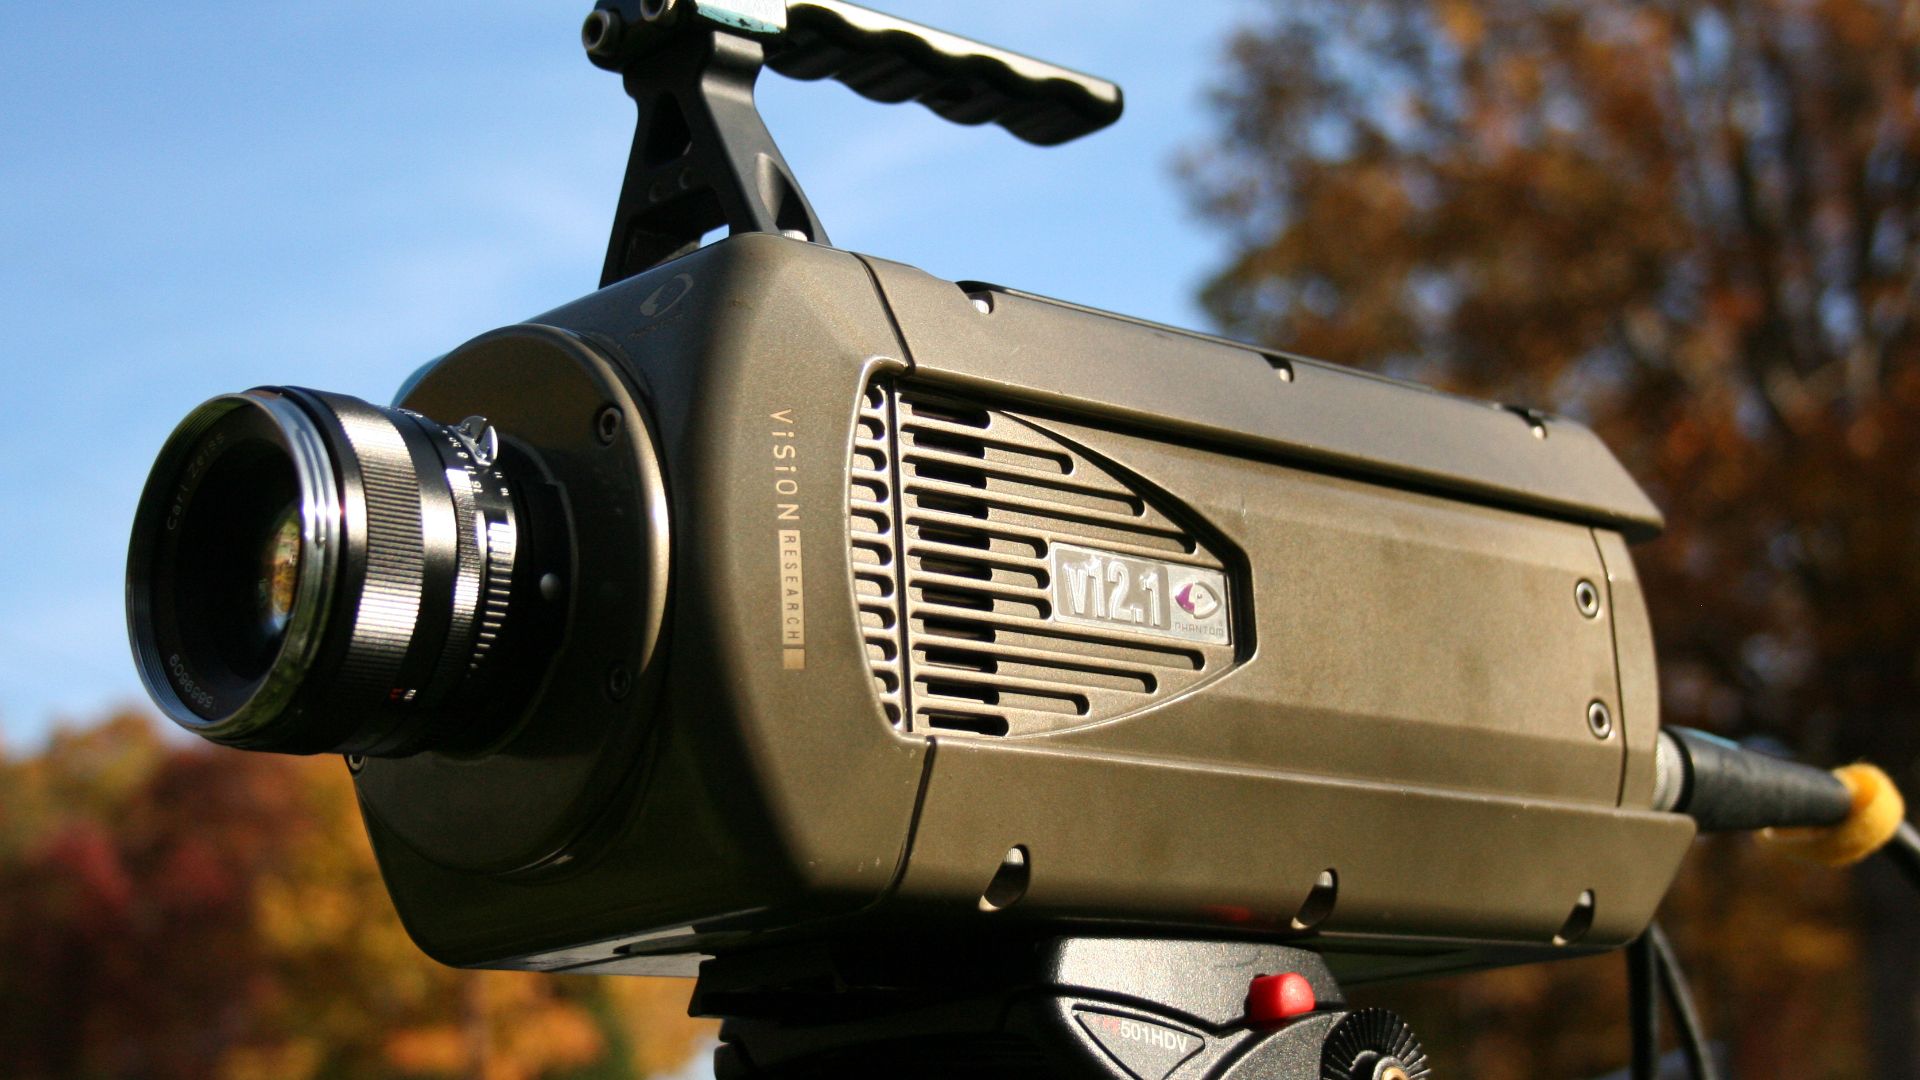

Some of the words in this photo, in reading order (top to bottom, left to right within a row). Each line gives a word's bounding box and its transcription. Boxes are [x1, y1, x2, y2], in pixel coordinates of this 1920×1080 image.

[783, 534, 801, 640] RESEARCH
[1063, 555, 1161, 627] v12.1
[1174, 621, 1224, 637] PHANTOM
[1120, 1020, 1188, 1053] 501HDV
